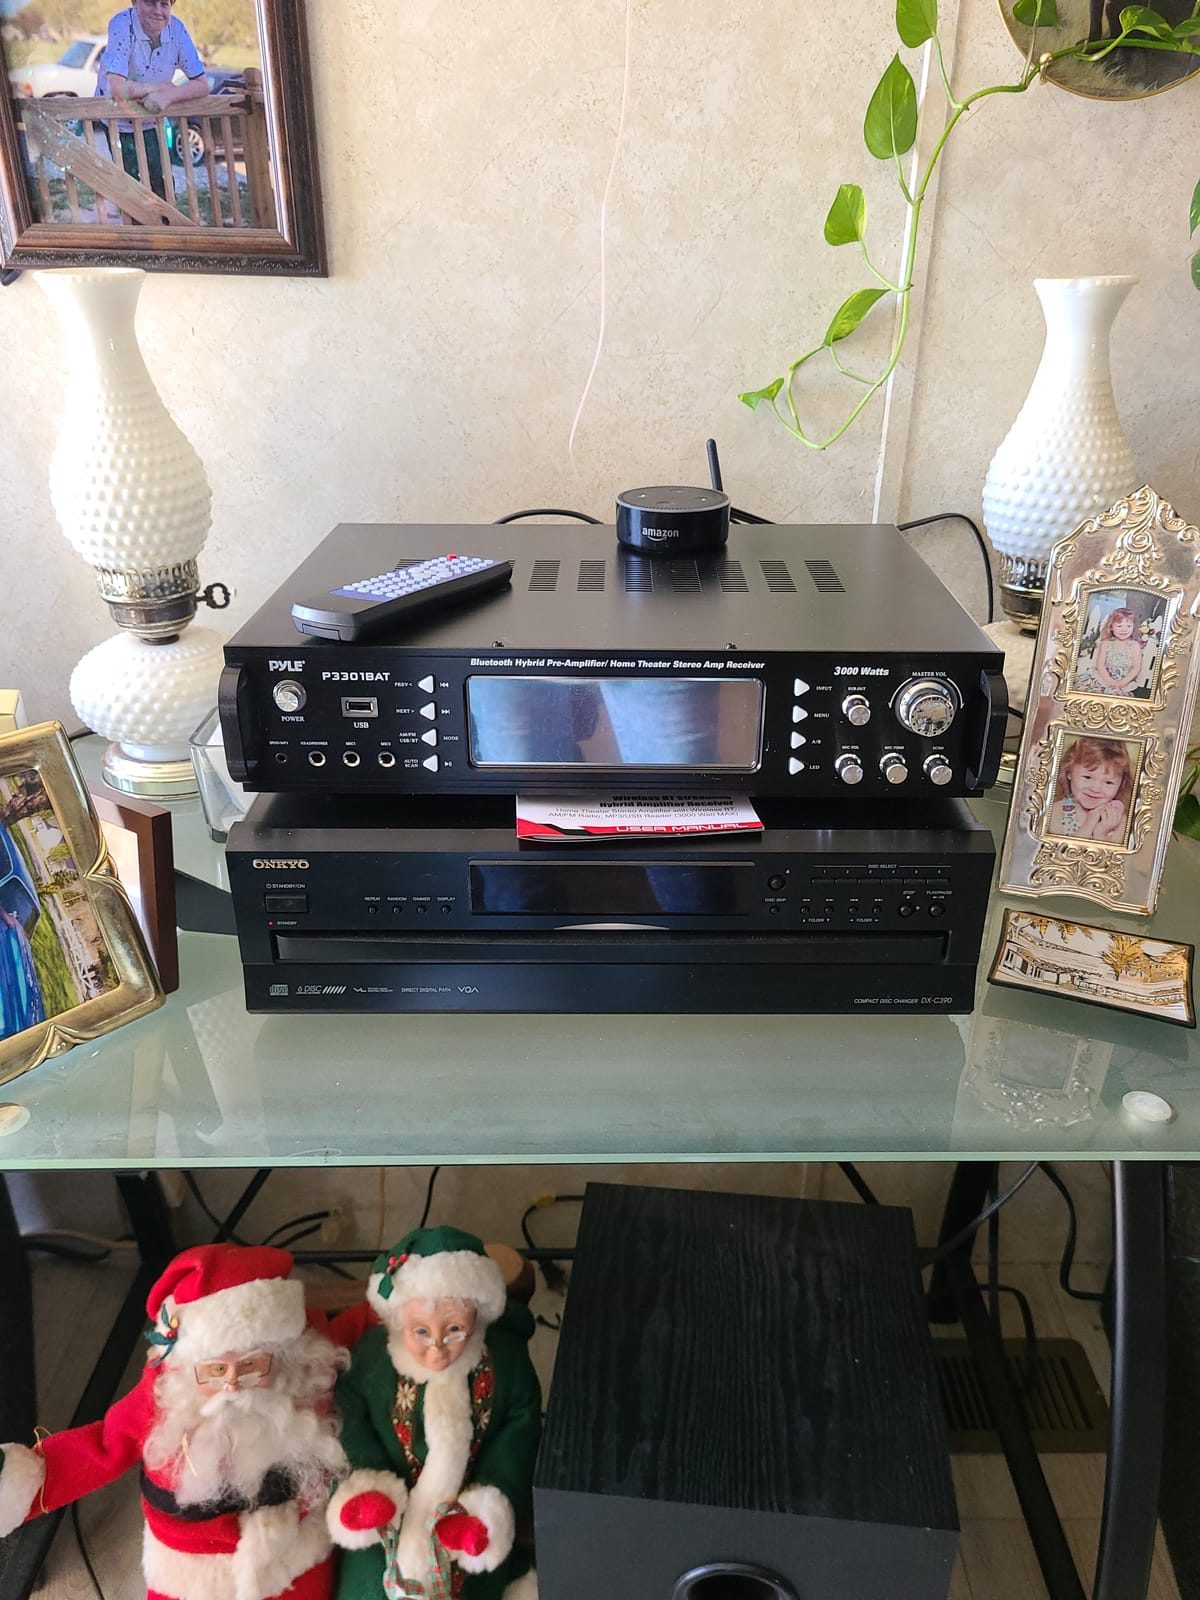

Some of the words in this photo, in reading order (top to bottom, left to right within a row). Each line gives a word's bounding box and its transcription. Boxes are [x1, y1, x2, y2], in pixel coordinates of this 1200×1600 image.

[642, 527, 679, 537] amazon
[268, 660, 304, 672] PYLE
[470, 658, 512, 666] Bluetooth
[515, 659, 545, 668] Hybrid
[546, 659, 609, 668] Pre-Amplifier/
[609, 659, 636, 668] Home
[637, 660, 671, 668] Theater
[672, 660, 702, 669] Stereo
[703, 660, 725, 670] Amp
[726, 661, 765, 669] Receiver
[321, 671, 391, 681] P3301BAT
[833, 666, 859, 676] 3000
[860, 666, 890, 676] Watts
[353, 721, 370, 729] USB
[672, 823, 747, 832] MANUAL
[252, 859, 311, 869] ONKYO
